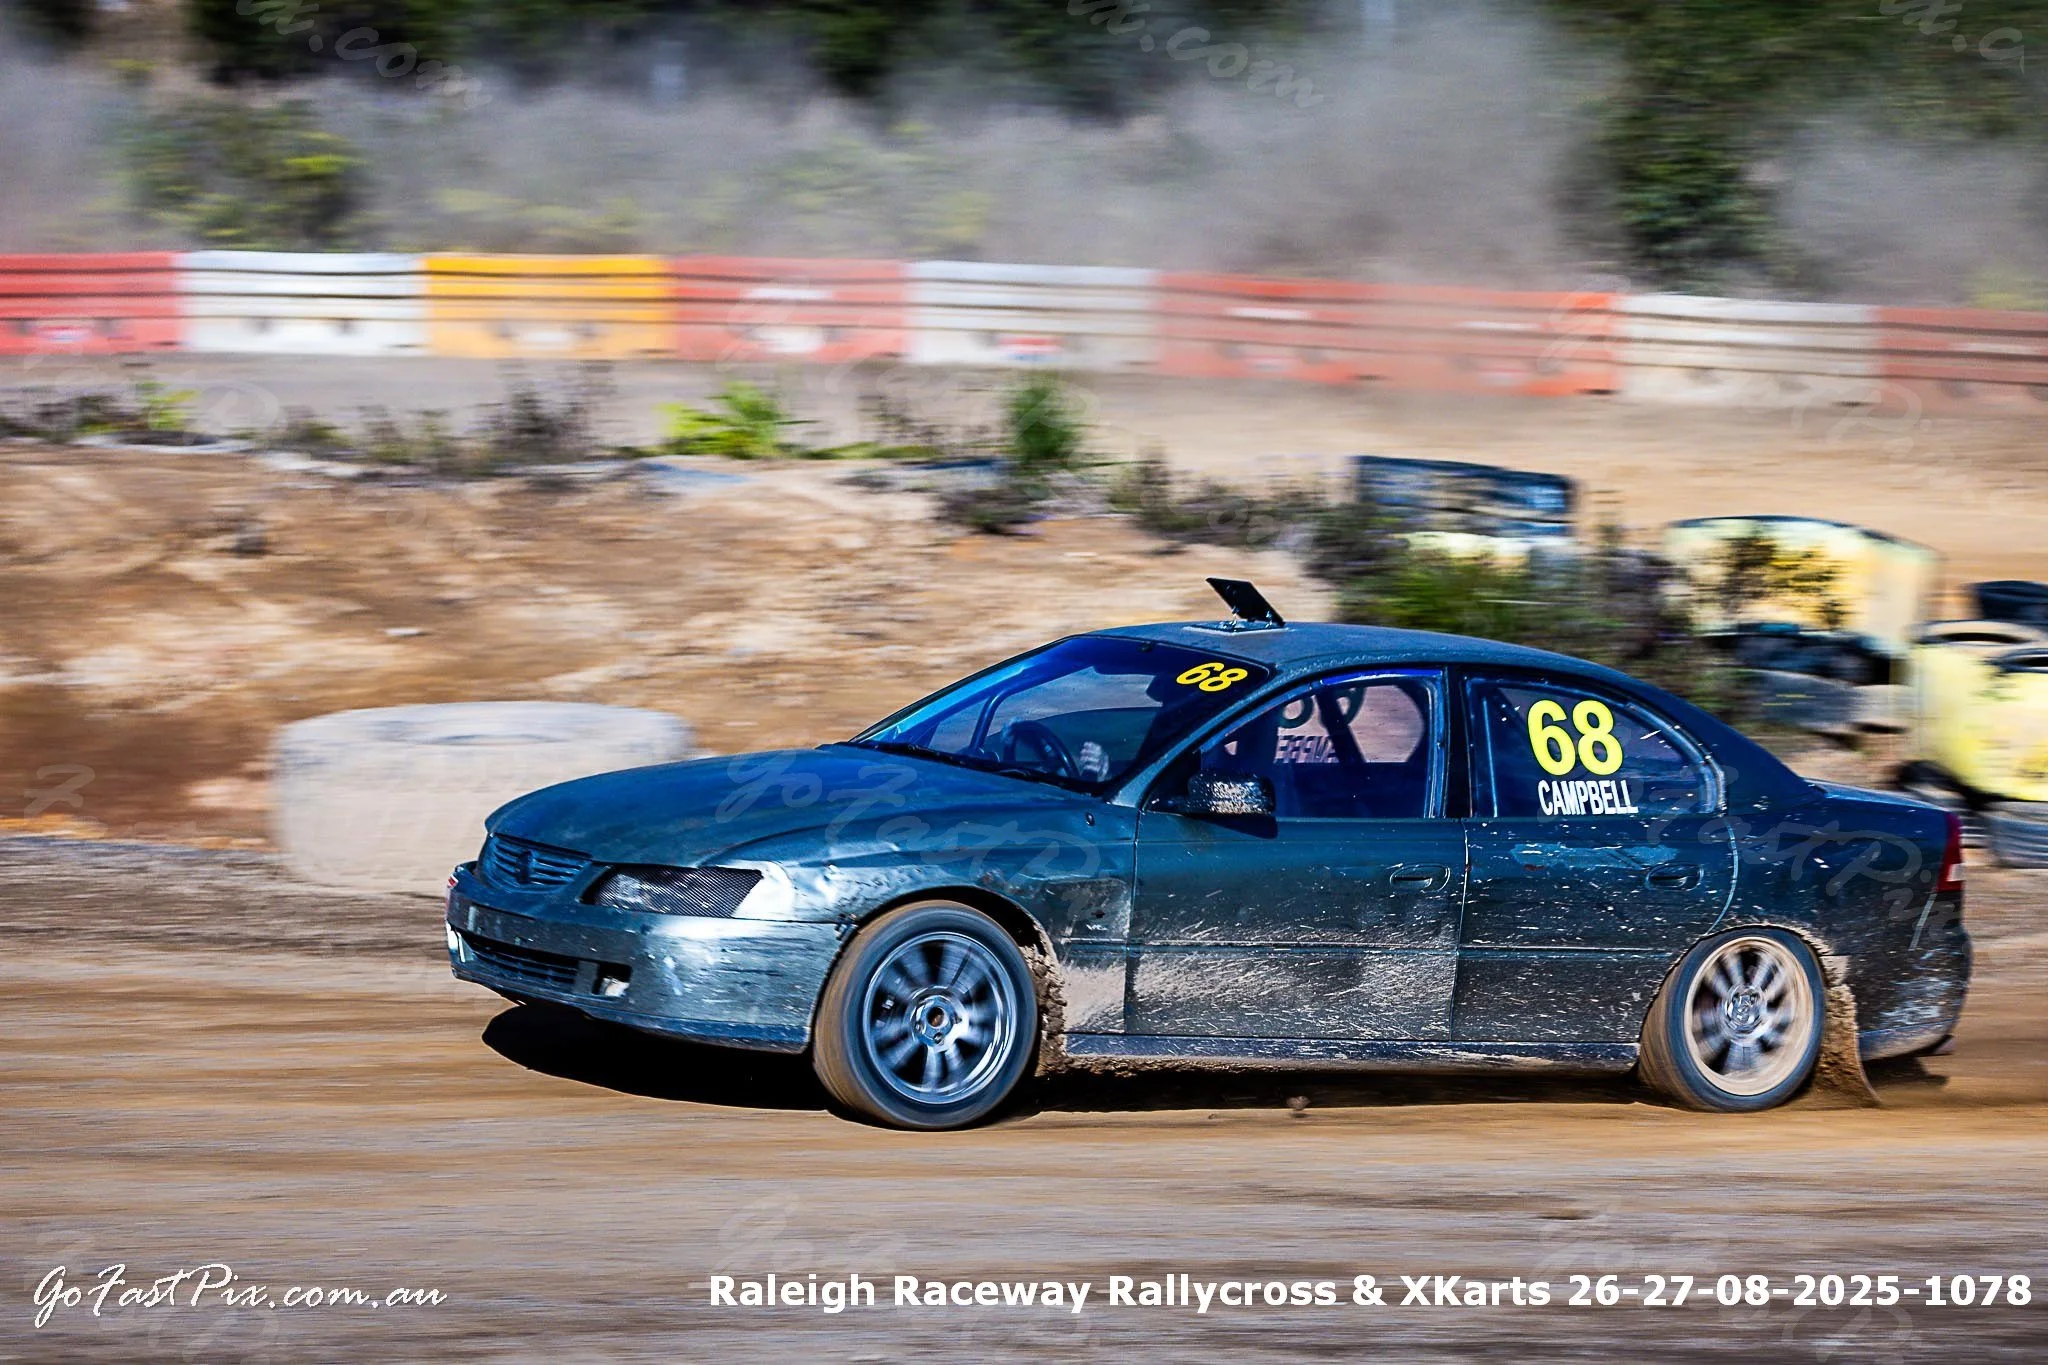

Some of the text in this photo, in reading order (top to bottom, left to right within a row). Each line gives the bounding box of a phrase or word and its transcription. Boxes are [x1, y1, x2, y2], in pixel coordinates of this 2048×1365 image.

[1176, 662, 1248, 692] 68
[1526, 699, 1624, 776] 68
[1537, 779, 1639, 816] CAMPBELL
